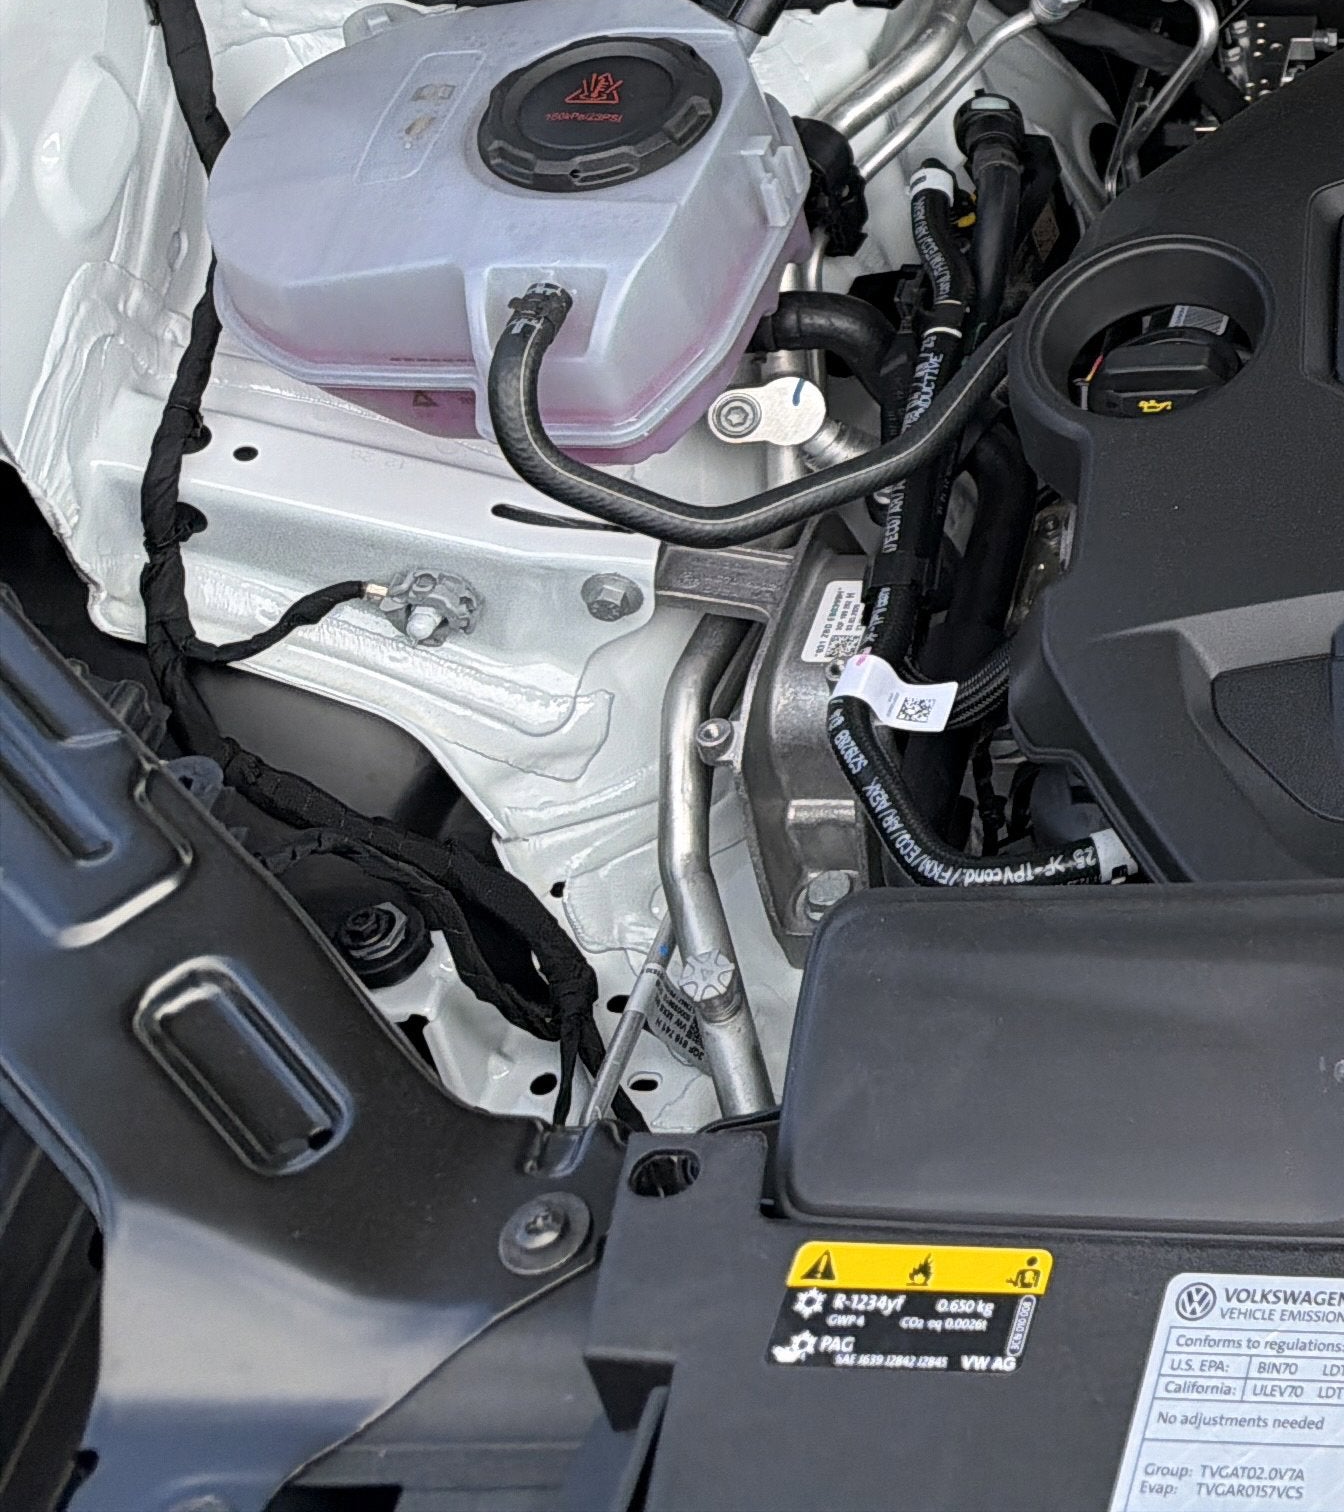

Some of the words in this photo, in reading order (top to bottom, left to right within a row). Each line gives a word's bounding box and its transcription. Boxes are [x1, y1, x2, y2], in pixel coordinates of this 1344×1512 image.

[832, 1294, 907, 1316] R-1234yf
[935, 1299, 975, 1314] 0.650
[976, 1300, 996, 1318] kg
[1219, 1307, 1275, 1322] VEHICLE
[818, 1336, 856, 1352] PAG
[1176, 1334, 1242, 1349] Conforms
[1246, 1337, 1261, 1350] to
[960, 1355, 989, 1371] VW
[990, 1355, 1017, 1372] AG
[1170, 1358, 1195, 1372] U.S.
[1199, 1359, 1230, 1373] EPA:
[1257, 1361, 1299, 1376] BIN70
[1164, 1380, 1237, 1396] California:
[1252, 1384, 1304, 1399] ULEV70
[1318, 1386, 1344, 1399] LDT
[1157, 1411, 1178, 1425] No
[1180, 1412, 1269, 1430] adjustments
[1272, 1416, 1326, 1431] needed
[1144, 1462, 1193, 1480] Group:
[1139, 1481, 1178, 1496] Evap:
